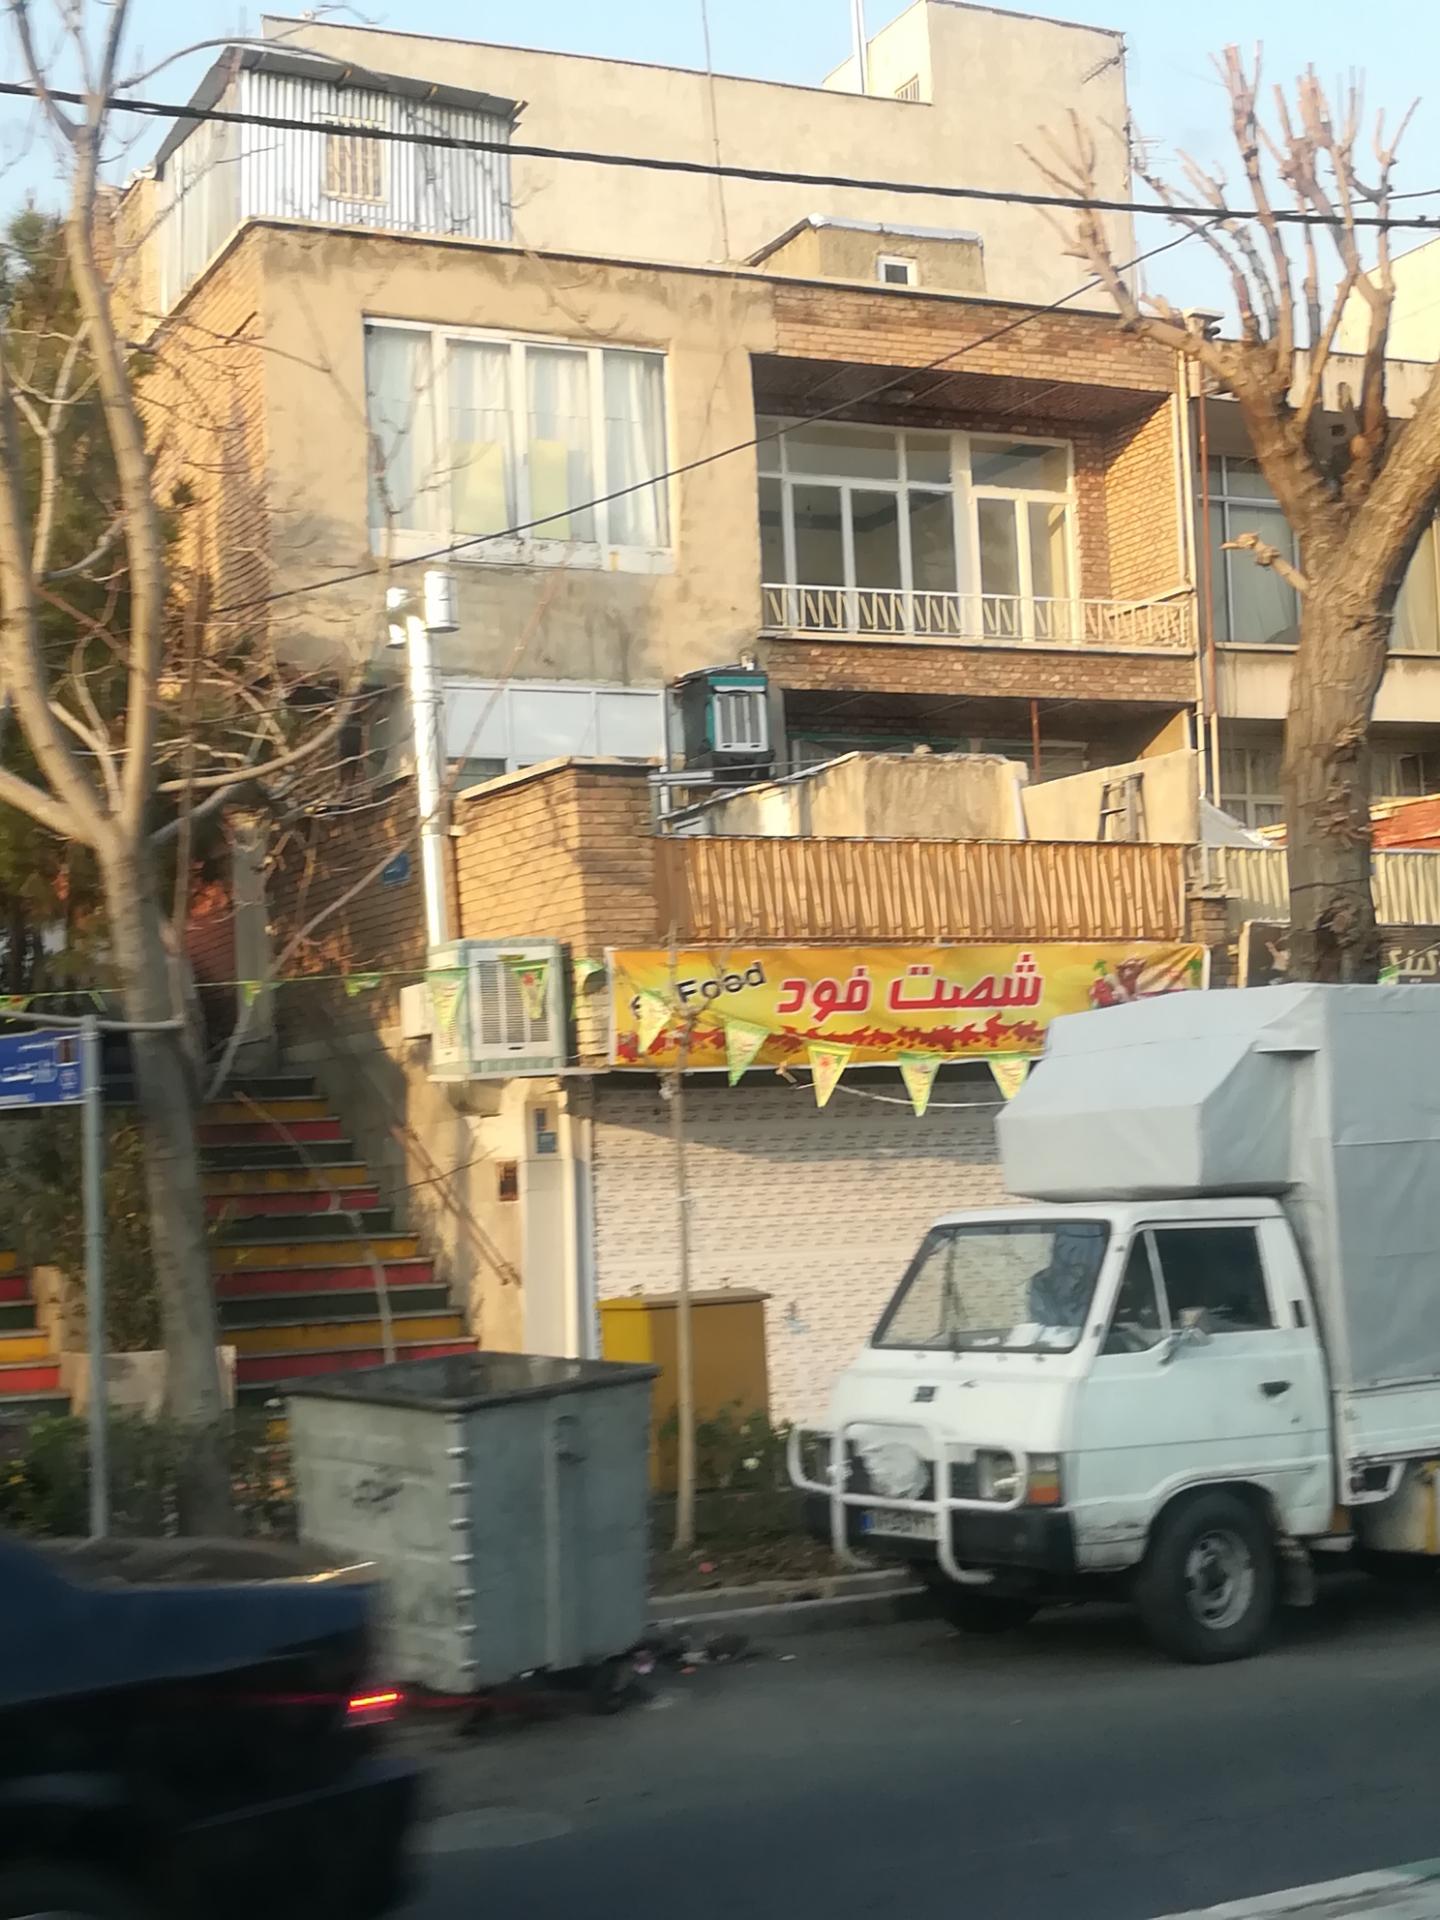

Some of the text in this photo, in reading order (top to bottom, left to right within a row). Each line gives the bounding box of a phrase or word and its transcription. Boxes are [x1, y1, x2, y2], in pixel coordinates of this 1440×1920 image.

[676, 961, 767, 1002] Food
[776, 953, 1044, 1023] شصت فود
